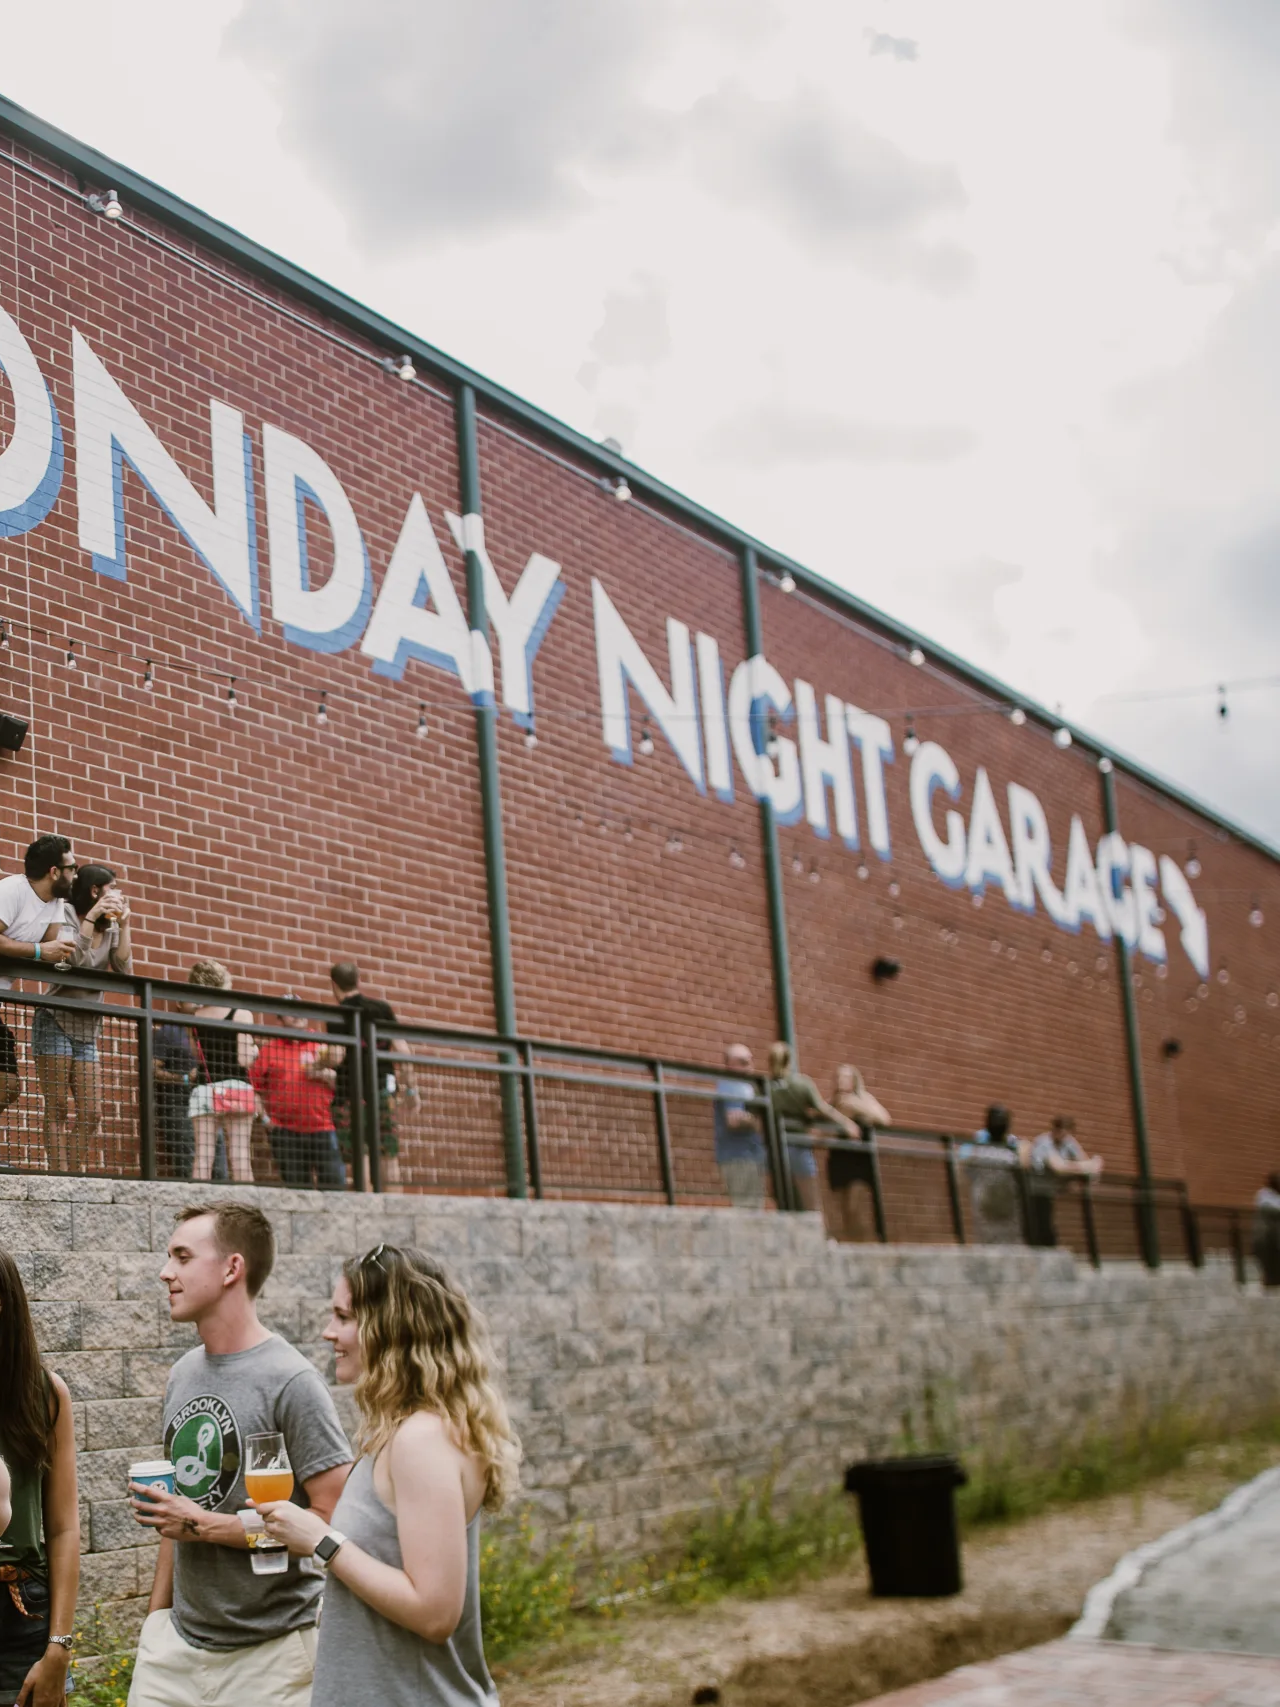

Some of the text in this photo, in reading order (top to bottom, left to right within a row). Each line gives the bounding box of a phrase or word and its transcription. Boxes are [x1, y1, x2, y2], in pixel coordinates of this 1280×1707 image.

[592, 576, 897, 860] NIGHT
[909, 740, 1167, 964] GARAGE
[172, 1398, 234, 1436] BROOKLYN
